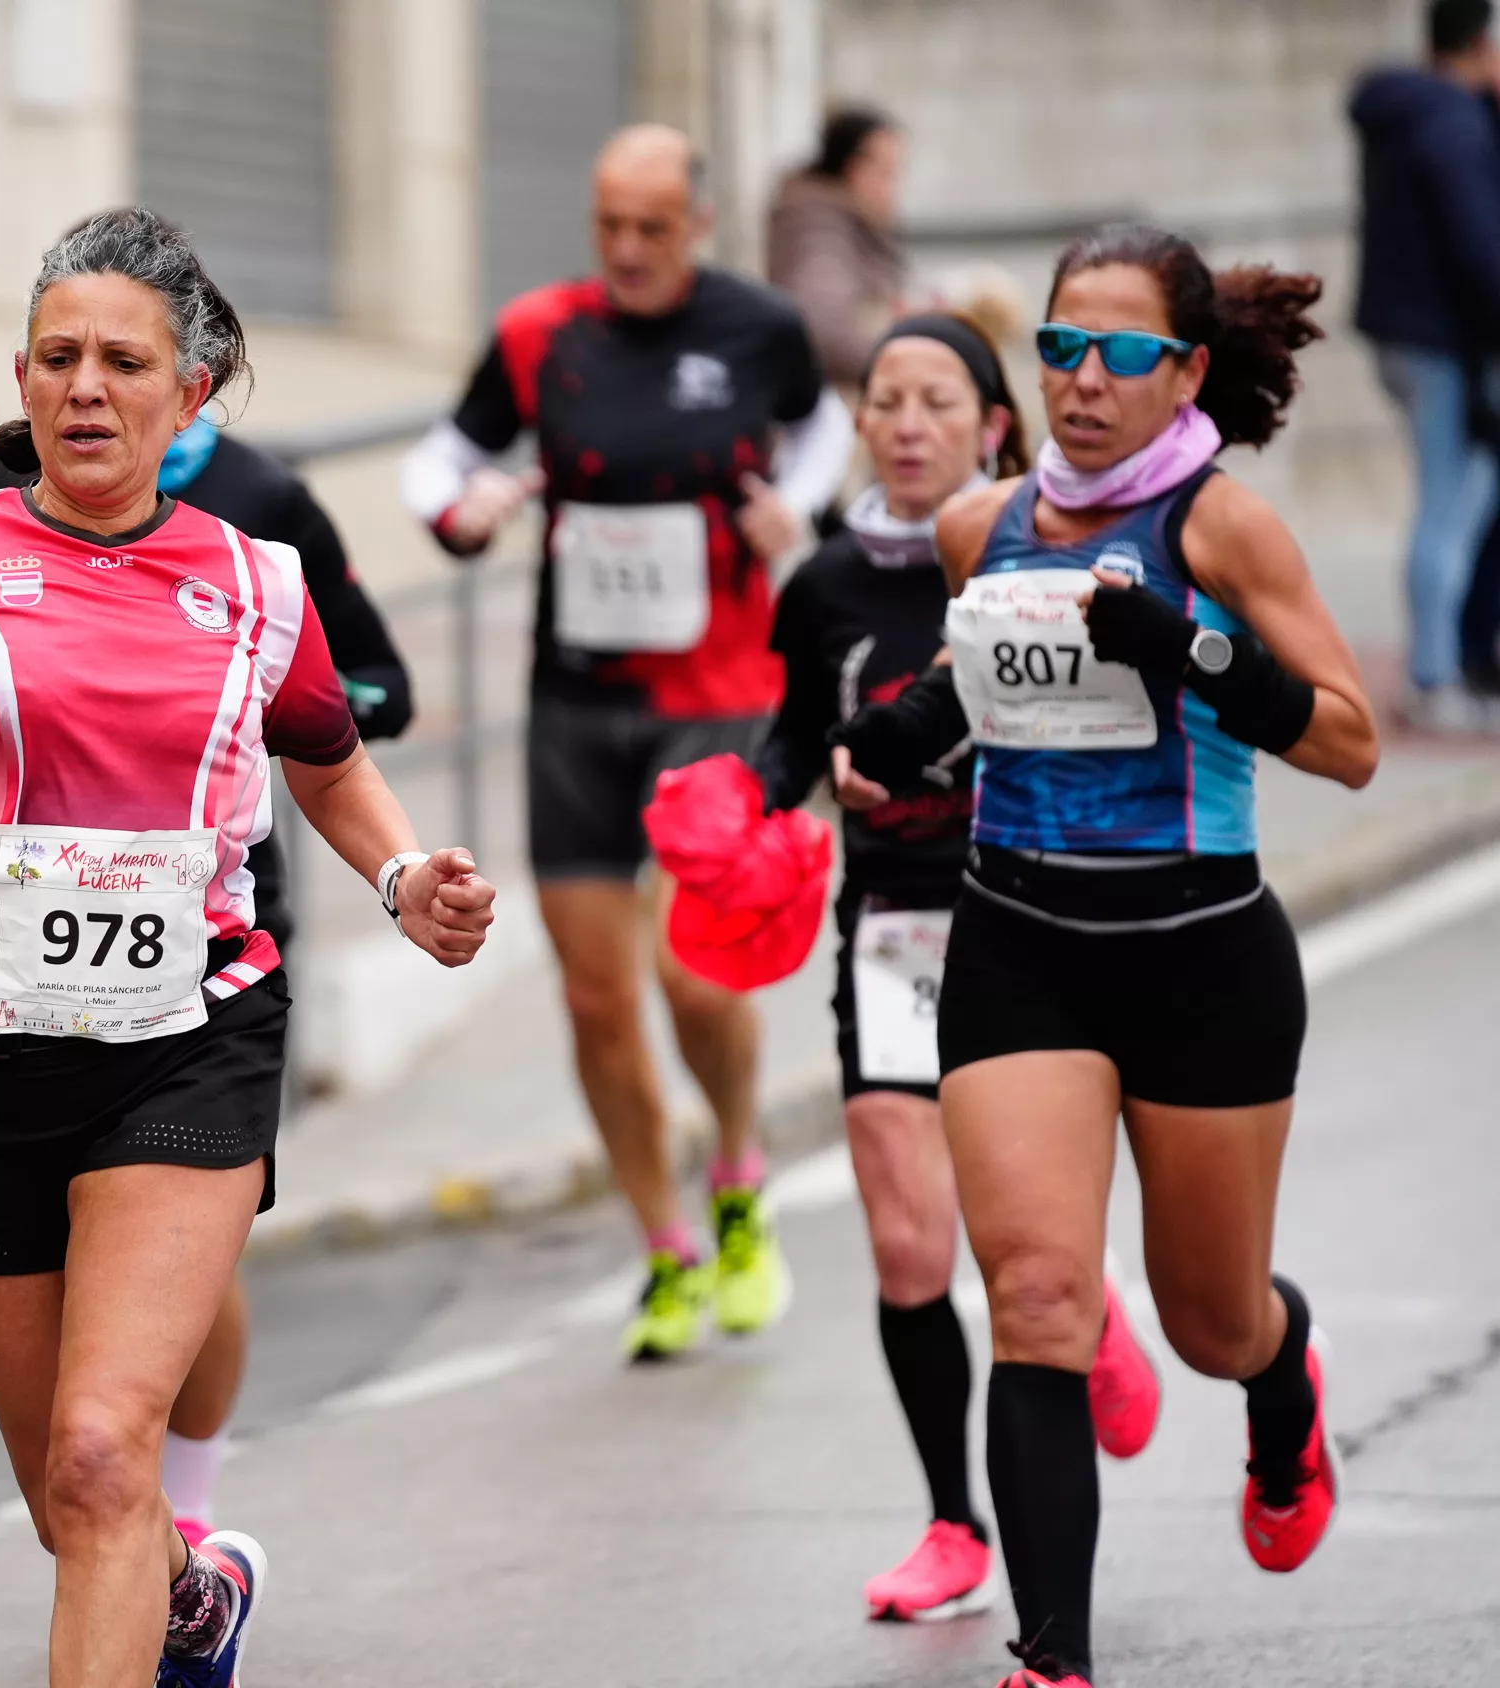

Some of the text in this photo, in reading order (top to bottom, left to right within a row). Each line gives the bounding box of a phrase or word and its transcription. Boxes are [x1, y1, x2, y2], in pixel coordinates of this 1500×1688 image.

[994, 641, 1083, 686] 807
[52, 842, 79, 872] X
[110, 852, 168, 868] MARATÓN
[78, 868, 152, 892] LUCENA
[42, 909, 165, 969] 978
[37, 982, 162, 994] MARÍA DEL PILAR SÁNCHEZ DIAZ
[85, 997, 117, 1006] L-Mujer
